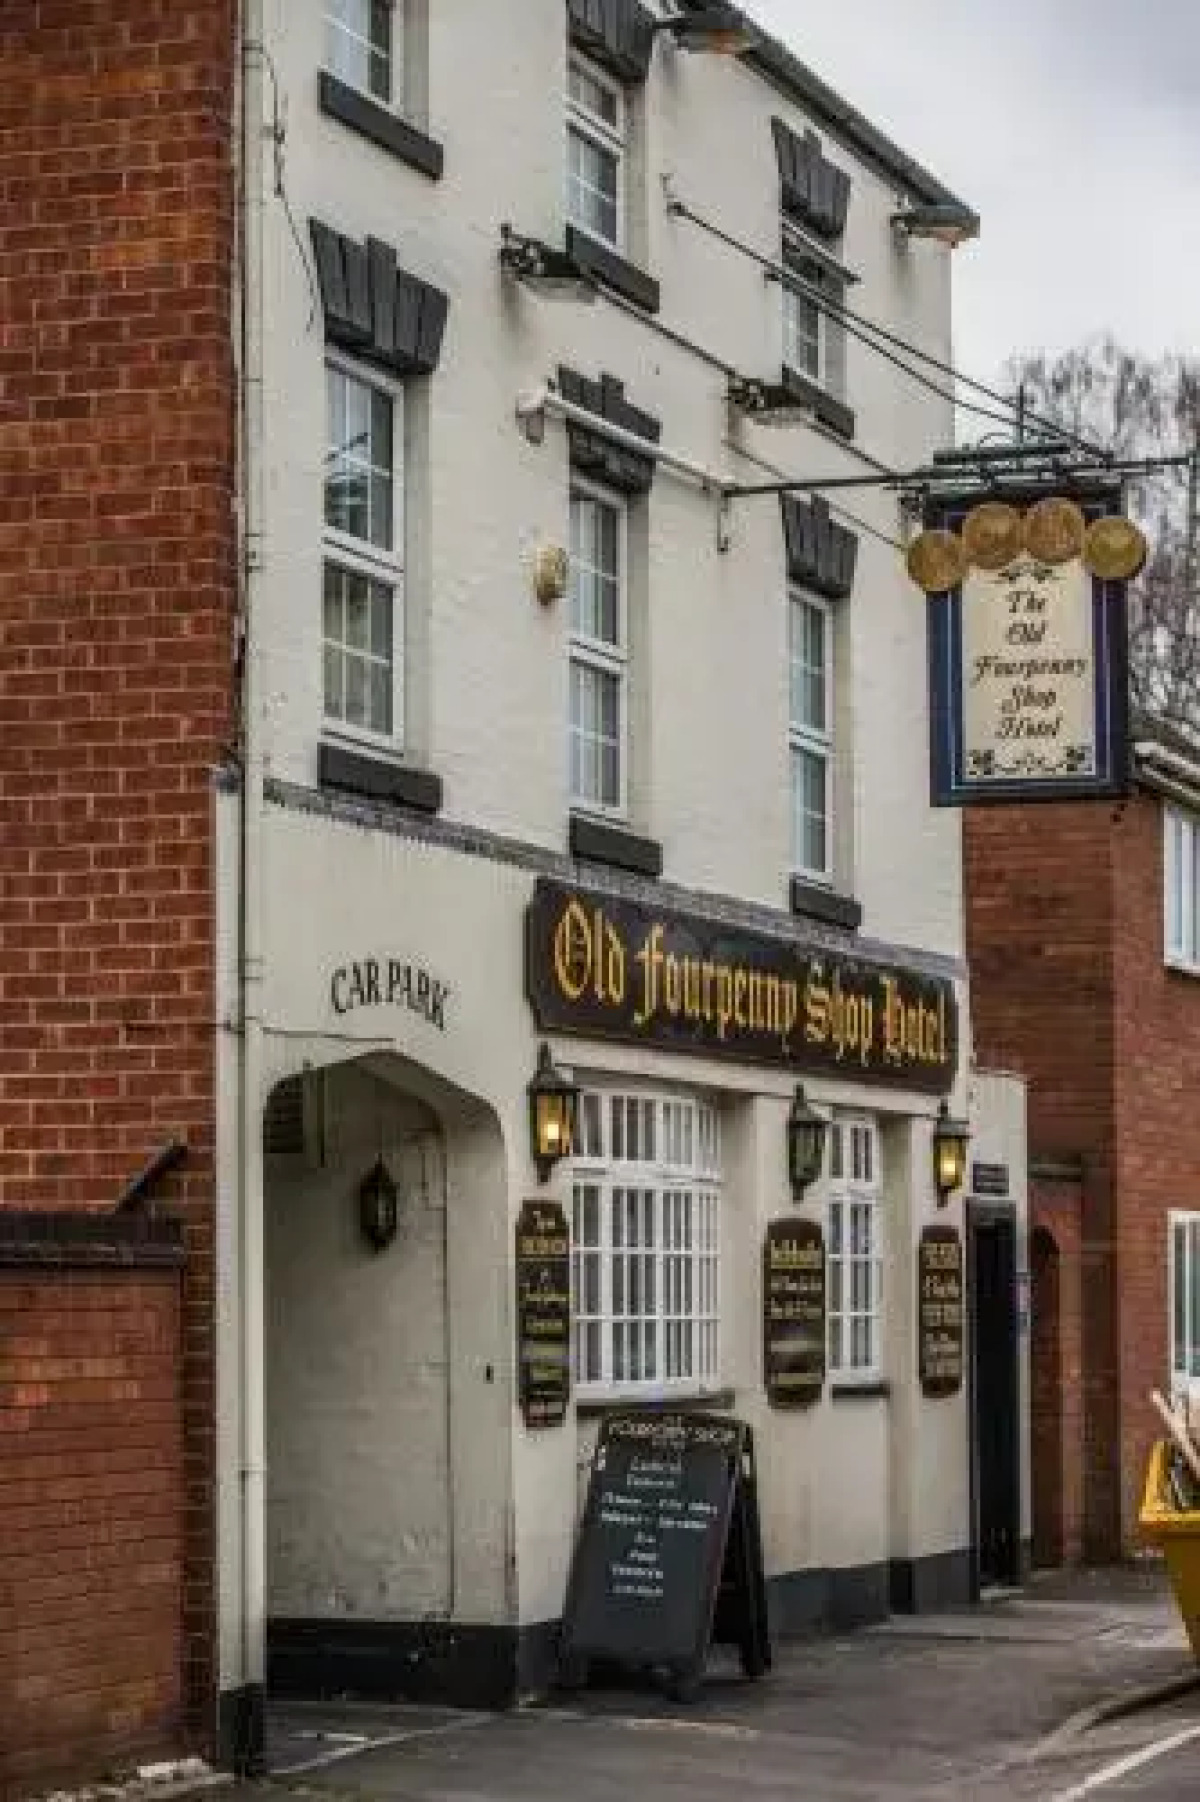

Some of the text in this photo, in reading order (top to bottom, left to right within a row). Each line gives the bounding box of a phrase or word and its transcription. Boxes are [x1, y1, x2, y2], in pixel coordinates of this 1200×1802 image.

[1006, 589, 1047, 614] The
[1005, 618, 1048, 645] Old
[968, 655, 1088, 689] Fourpenny
[1001, 684, 1057, 715] Shop
[995, 715, 1064, 740] Hotel
[330, 958, 449, 1032] CAR PARK
[553, 896, 628, 1005] Old
[804, 962, 875, 1067] Shop
